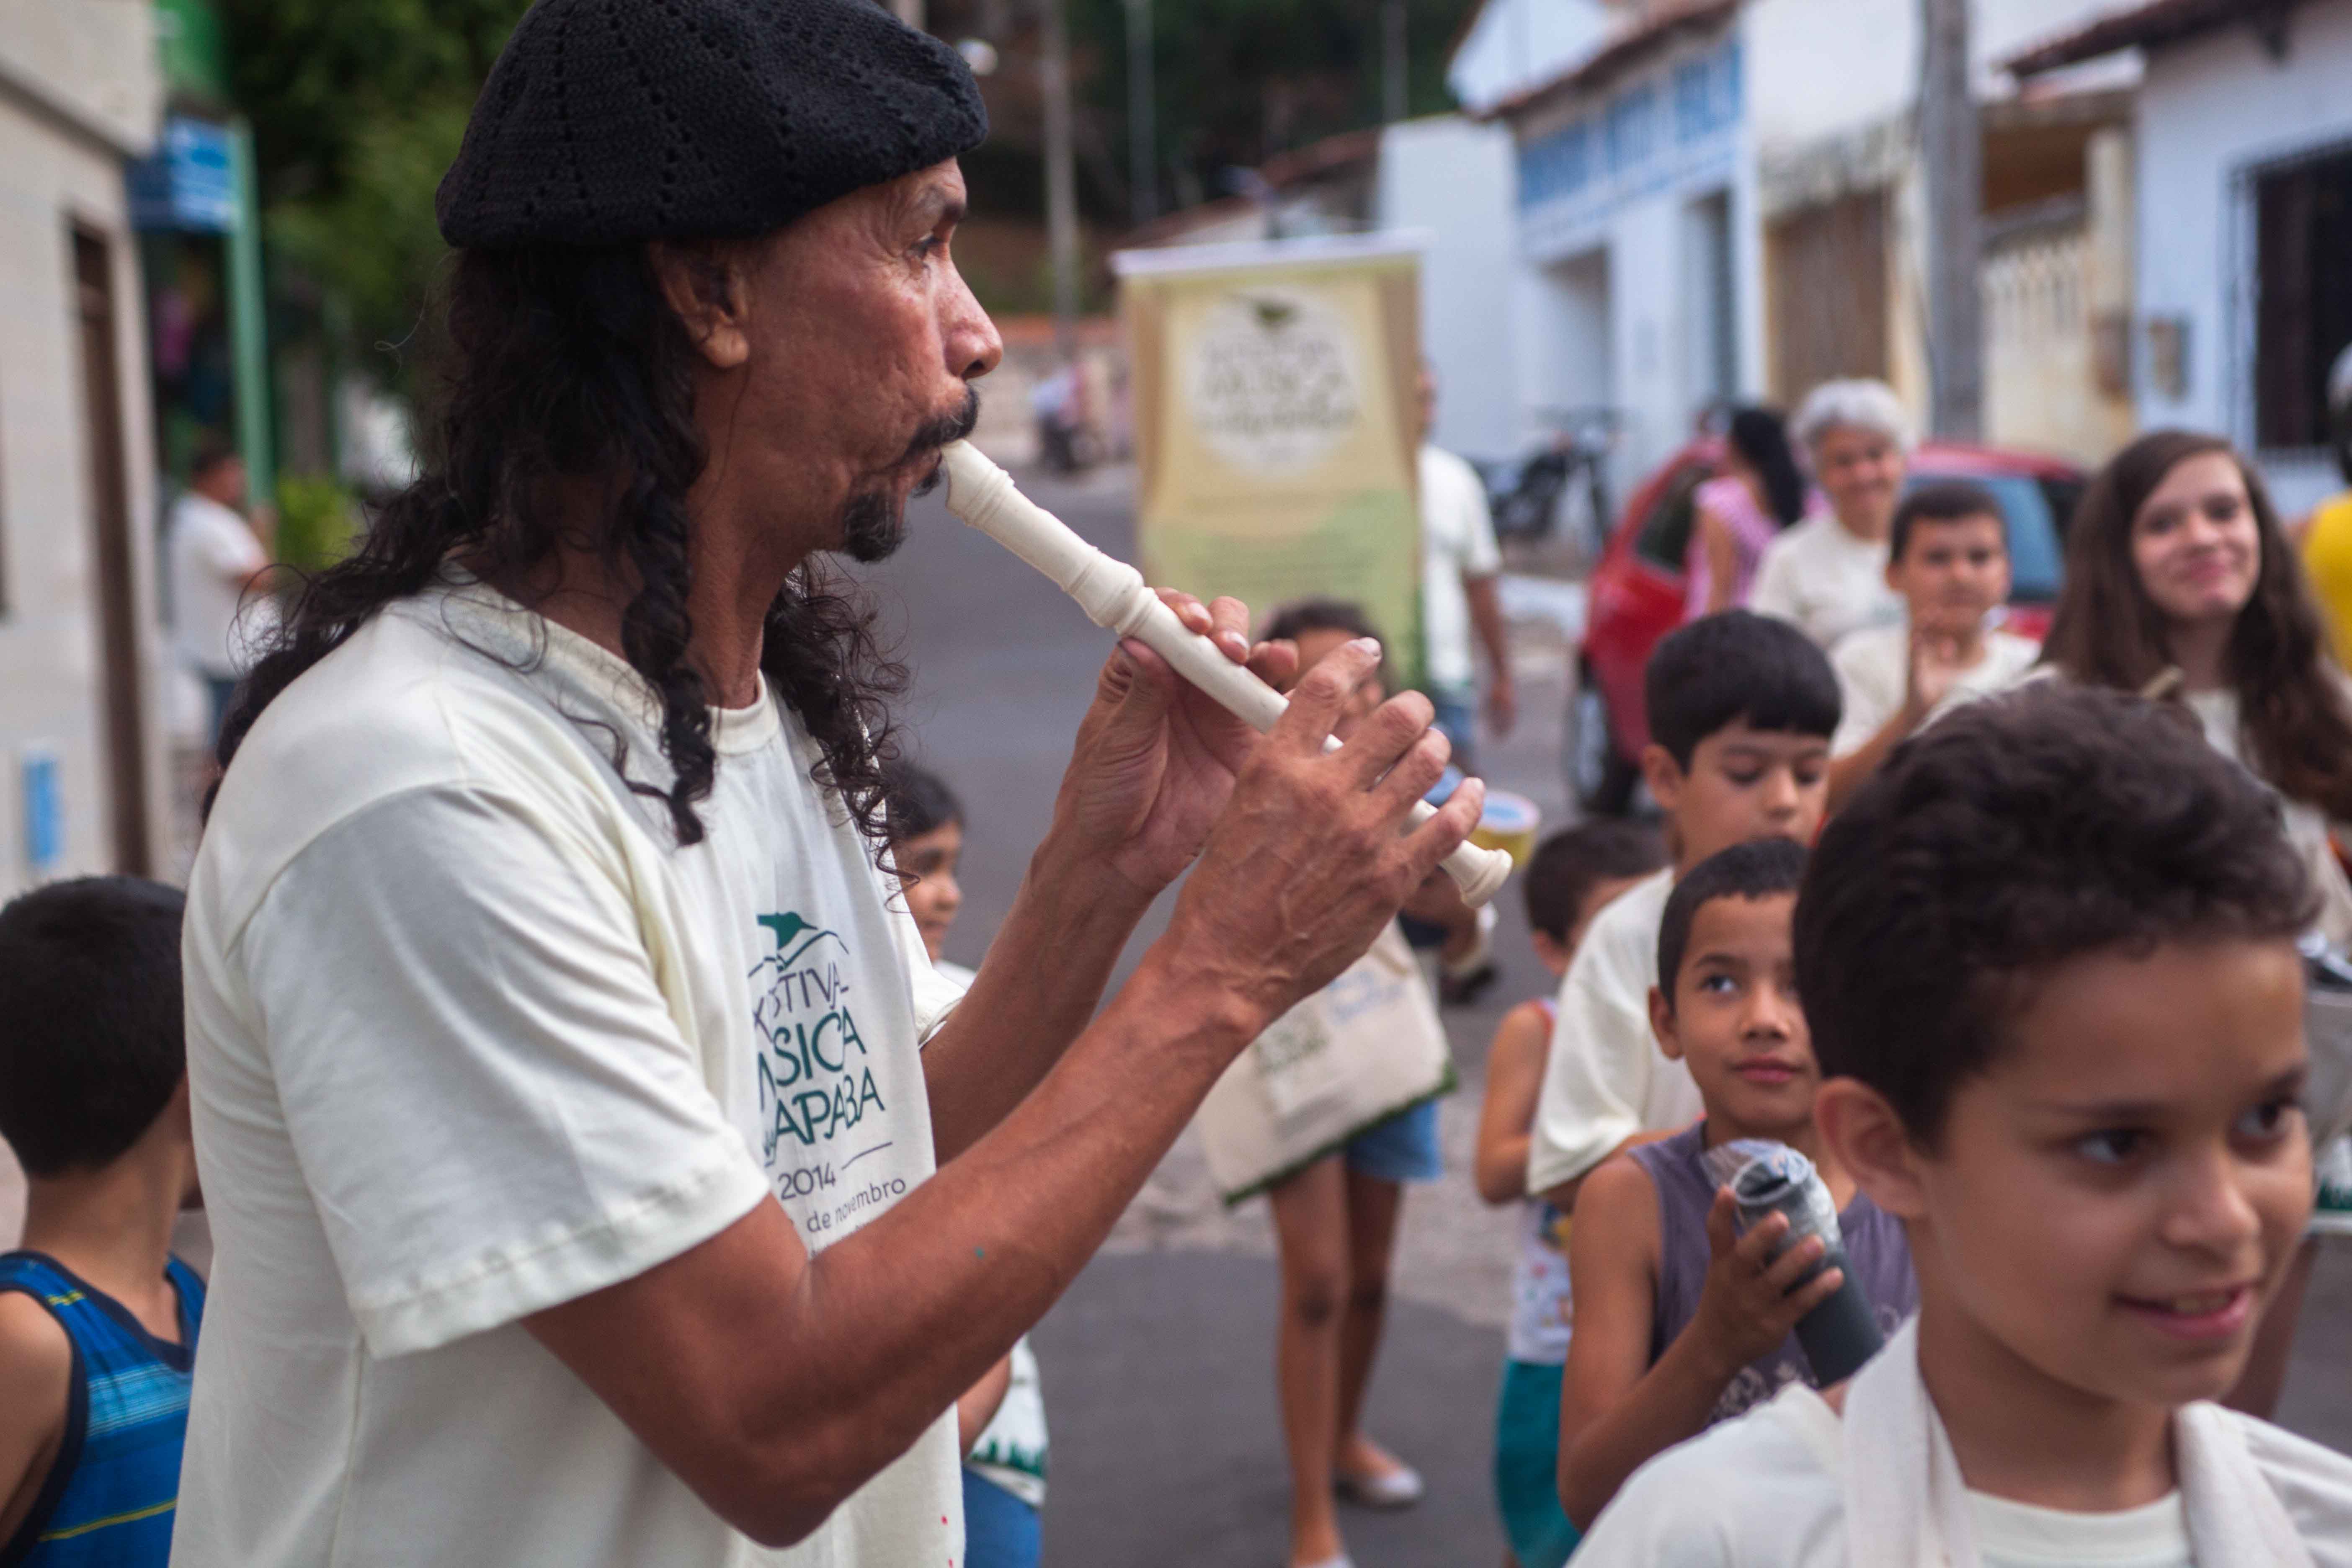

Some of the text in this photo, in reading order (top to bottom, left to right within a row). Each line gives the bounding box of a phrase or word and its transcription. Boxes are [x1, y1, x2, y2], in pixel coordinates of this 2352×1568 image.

[778, 1163, 836, 1200] 2014
[806, 1178, 906, 1233] de novembro
